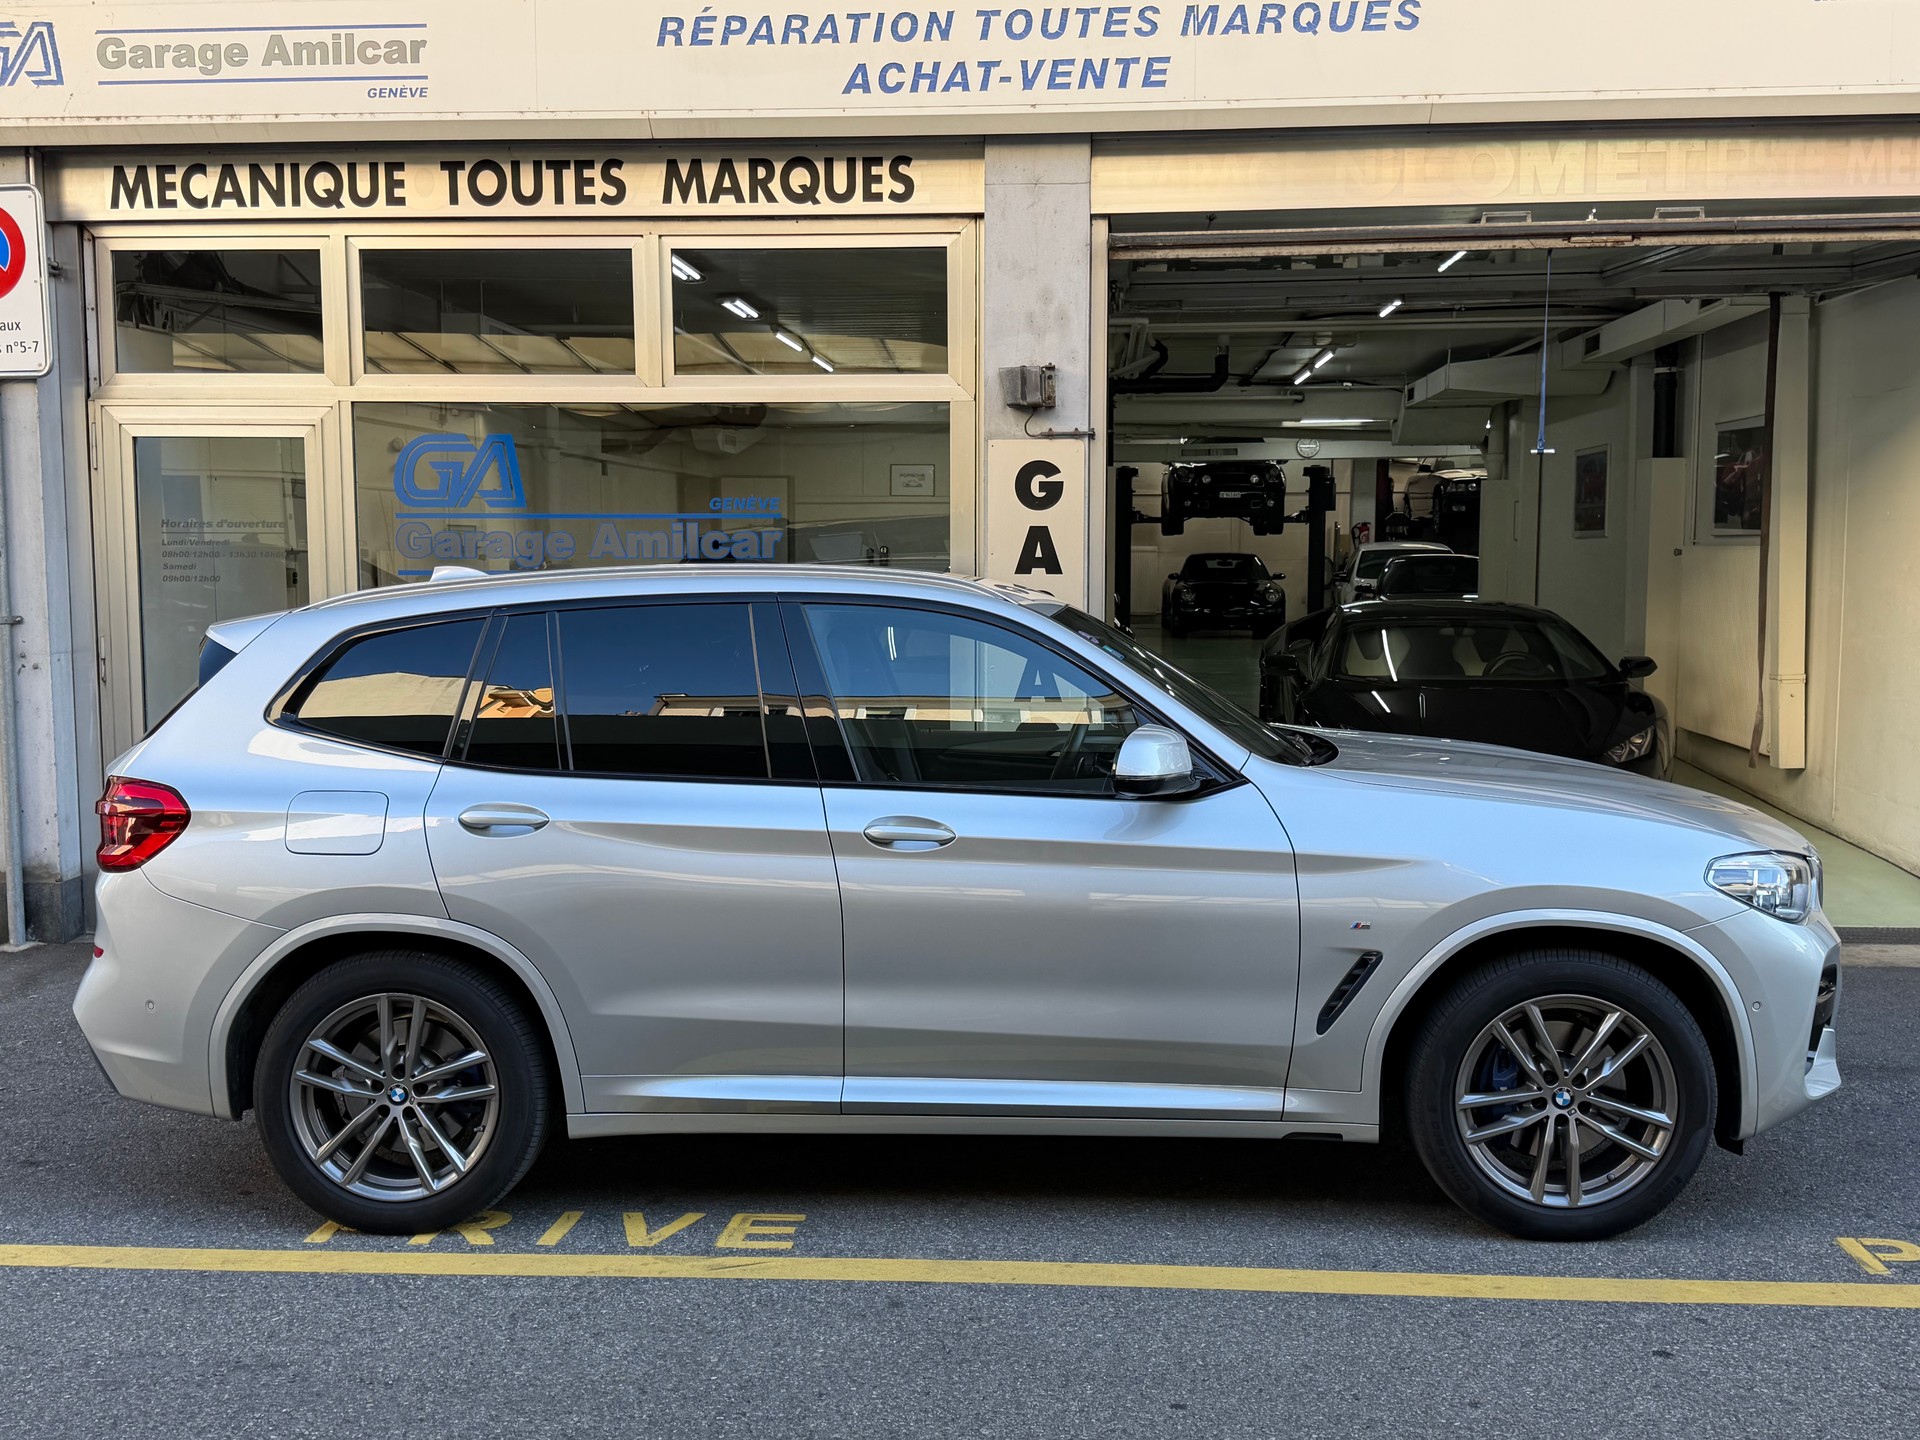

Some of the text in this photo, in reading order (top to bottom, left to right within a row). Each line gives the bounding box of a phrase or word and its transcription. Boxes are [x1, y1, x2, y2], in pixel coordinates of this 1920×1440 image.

[656, 0, 1420, 47] RÉPARATION TOUTES MARQUES
[96, 33, 428, 76] Garage Amilcar
[366, 84, 429, 99] GENÈVE
[842, 56, 1172, 95] ACHAT-VENTE
[110, 155, 916, 209] MECANIQUE TOUTES MARQUES
[6, 341, 39, 354] n°5-7
[393, 434, 528, 508] GA
[709, 495, 783, 511] GENÈVE
[161, 518, 213, 529] Horaires
[395, 521, 785, 570] Garage Amilcar
[162, 562, 197, 571] Samedi
